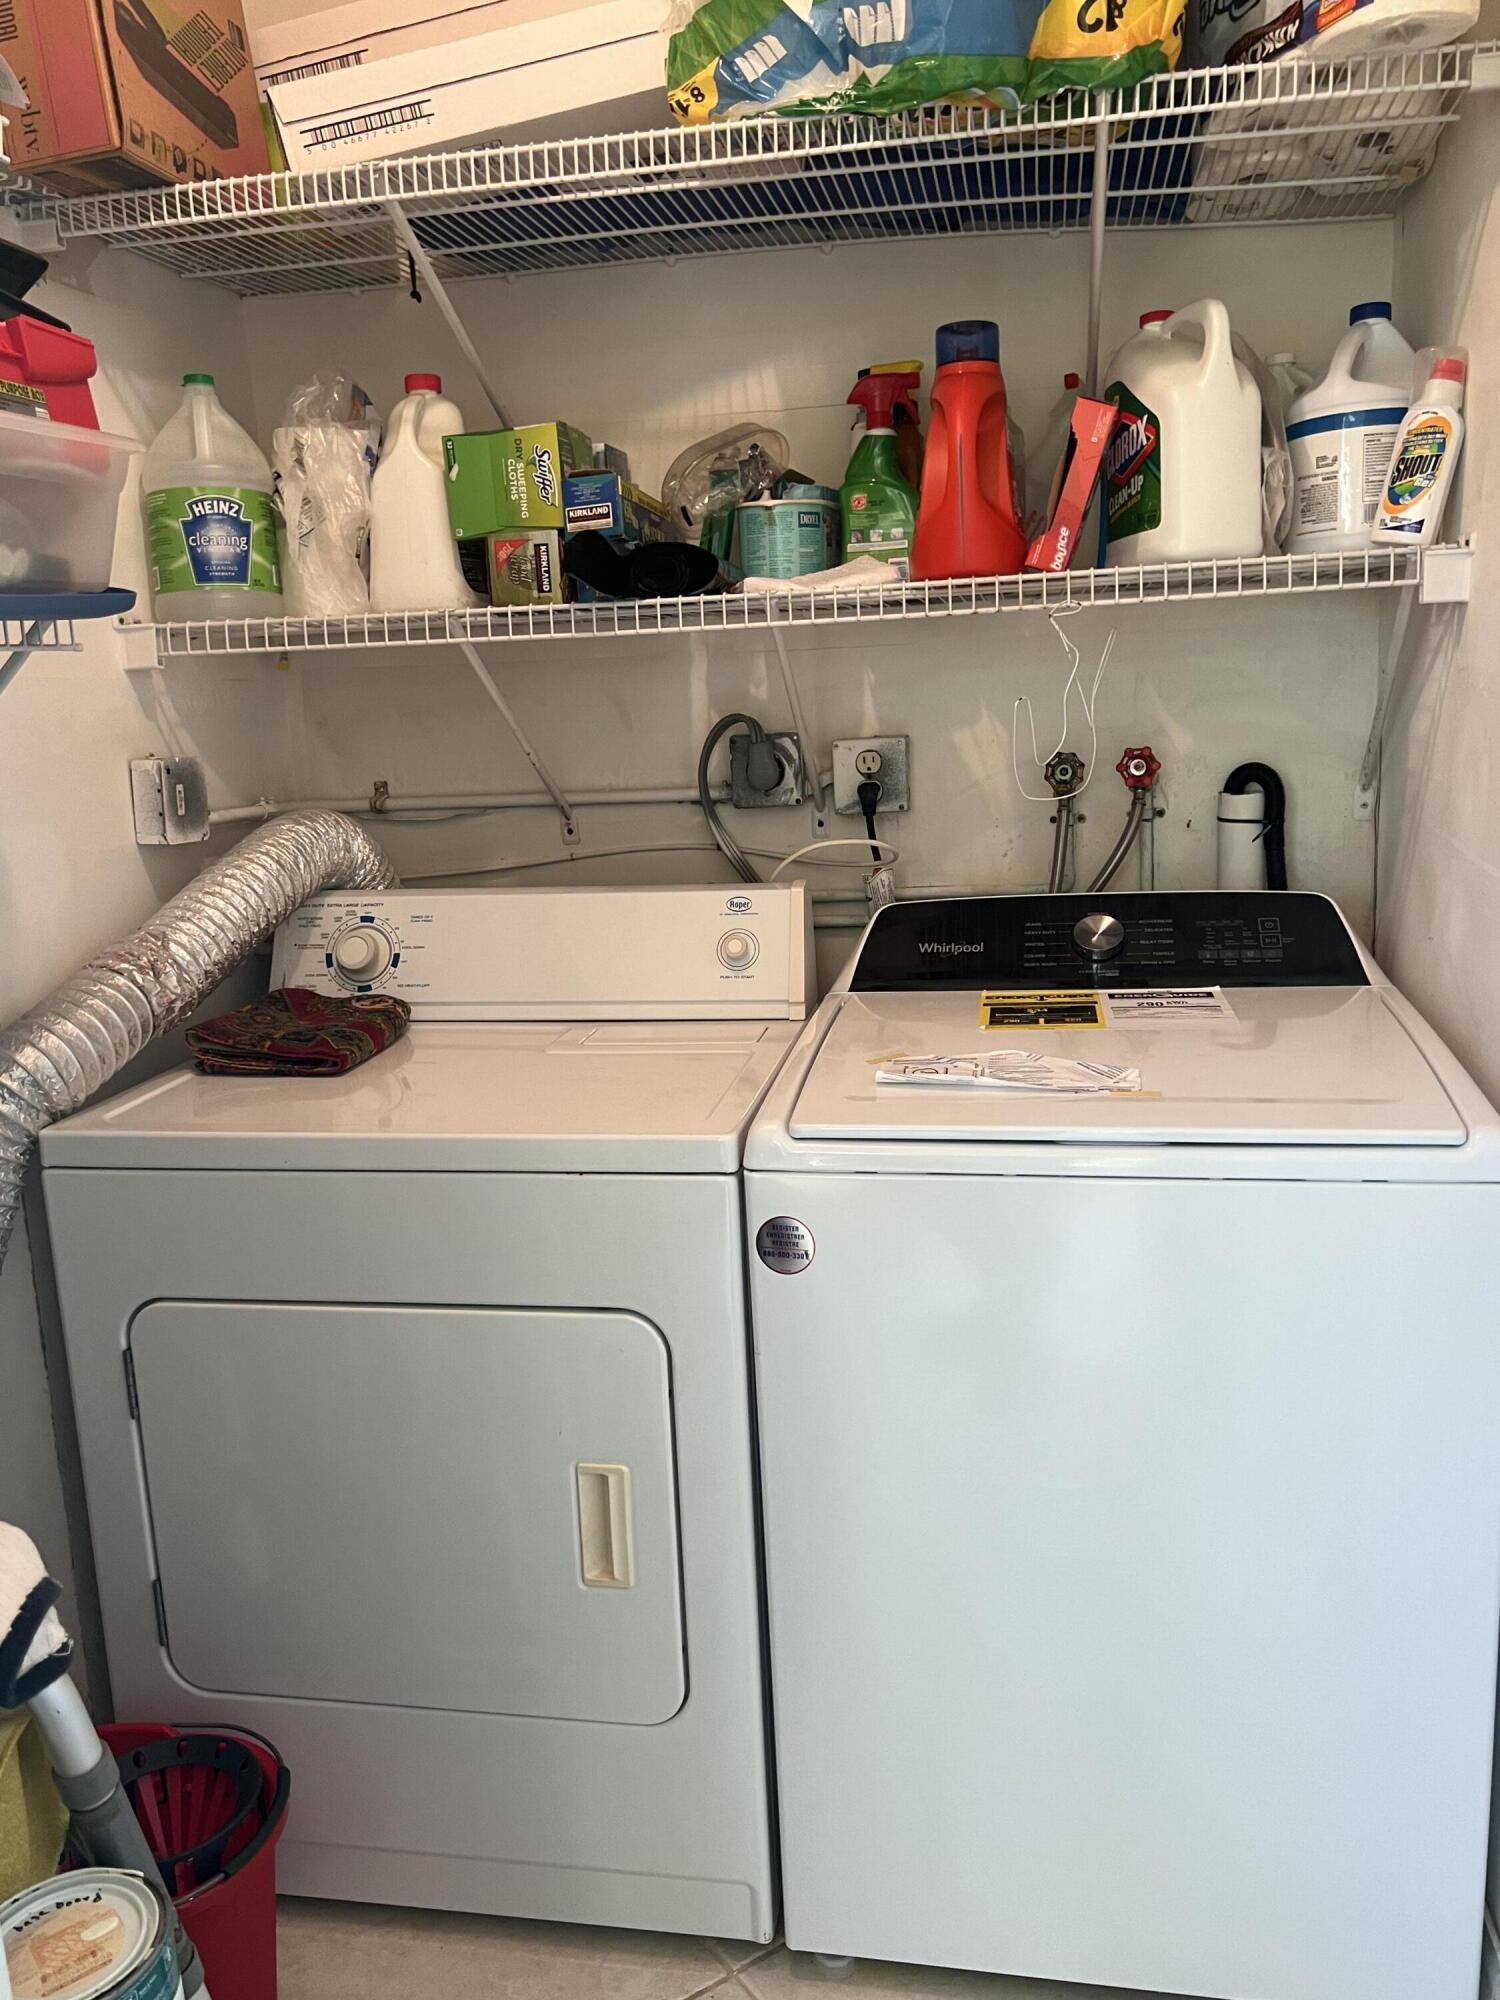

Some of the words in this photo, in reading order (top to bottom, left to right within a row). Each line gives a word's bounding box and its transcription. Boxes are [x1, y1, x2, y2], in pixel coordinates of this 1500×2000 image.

[167, 9, 225, 67] TERMINAL
[196, 38, 249, 92] INTERNET
[425, 116, 432, 125] 2
[514, 438, 523, 463] DRY
[506, 458, 519, 502] CLOTHS
[532, 443, 557, 506] Swiffer
[1390, 453, 1443, 486] SHOUT
[515, 462, 529, 519] SWEEPING
[191, 500, 240, 517] HEINZ
[569, 506, 609, 518] KIRKLAND
[188, 532, 249, 551] cleaning
[1051, 526, 1071, 572] bounce
[539, 545, 551, 593] KIRKLAND
[729, 900, 750, 909] Roper
[918, 941, 984, 958] Whirlpool
